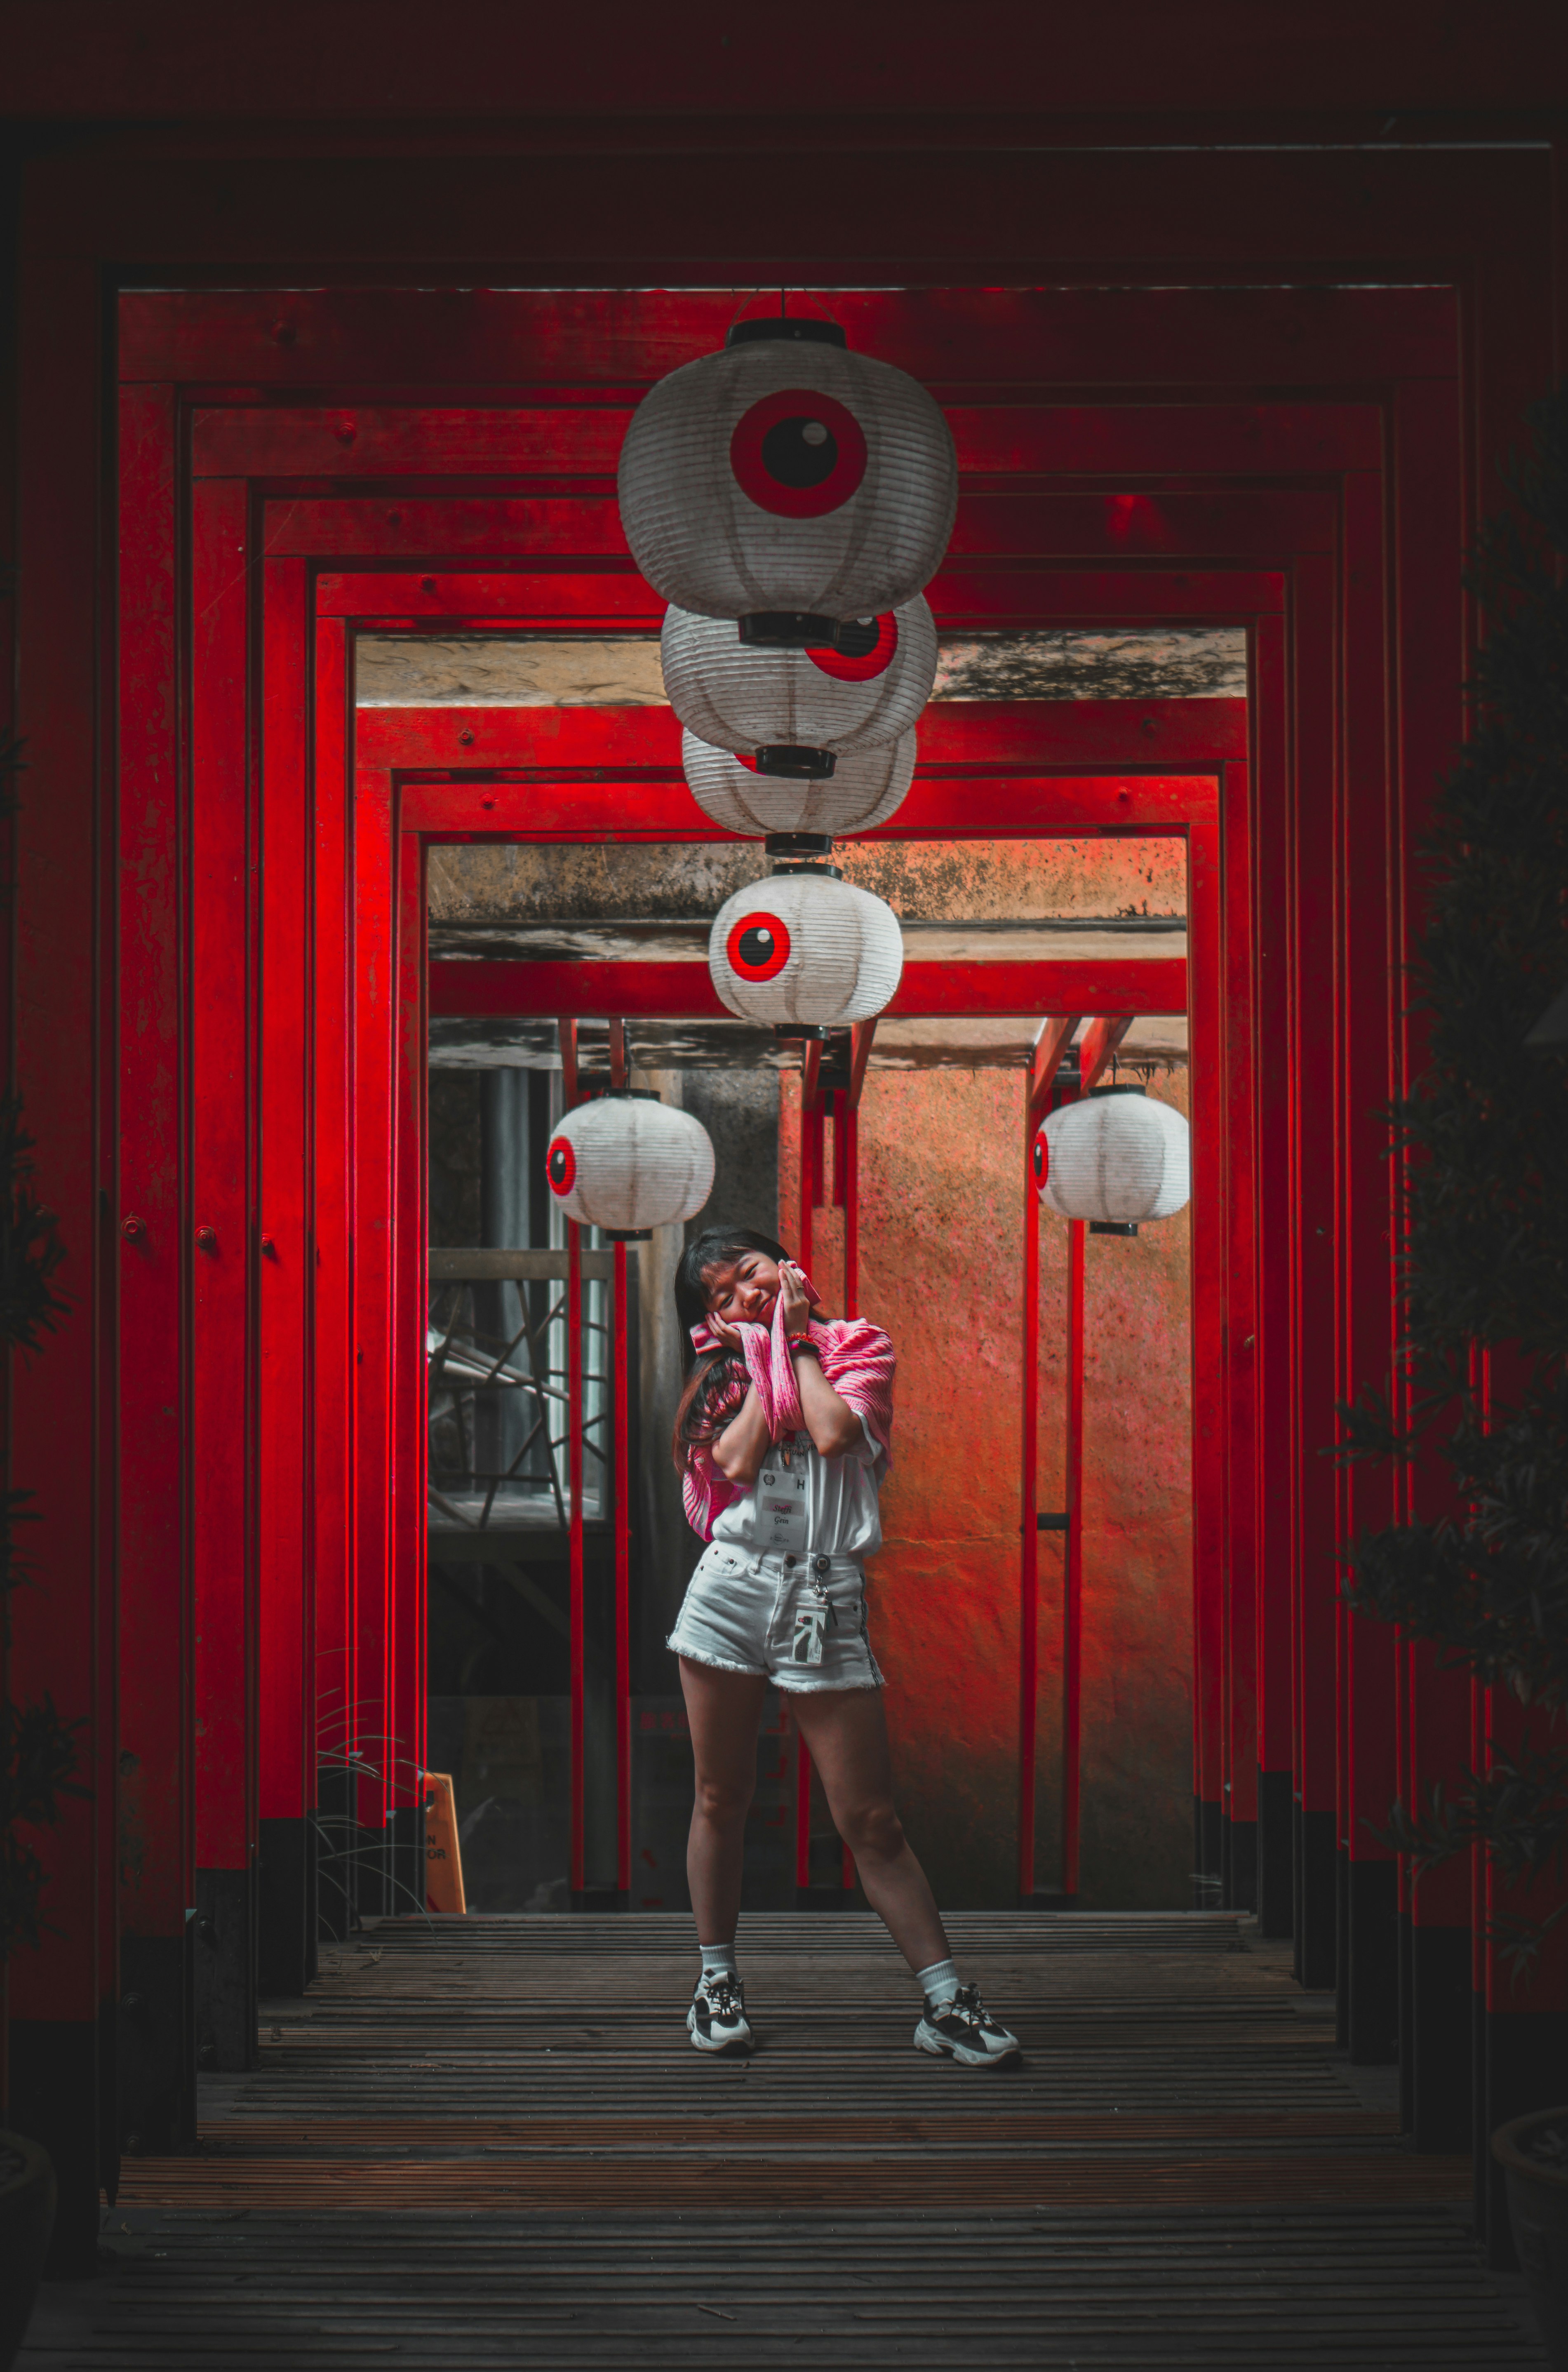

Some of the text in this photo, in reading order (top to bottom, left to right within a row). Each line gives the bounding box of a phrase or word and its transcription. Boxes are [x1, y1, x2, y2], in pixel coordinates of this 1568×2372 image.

[797, 1479, 805, 1490] H
[773, 1505, 792, 1515] Steffi
[774, 1516, 789, 1525] Gein
